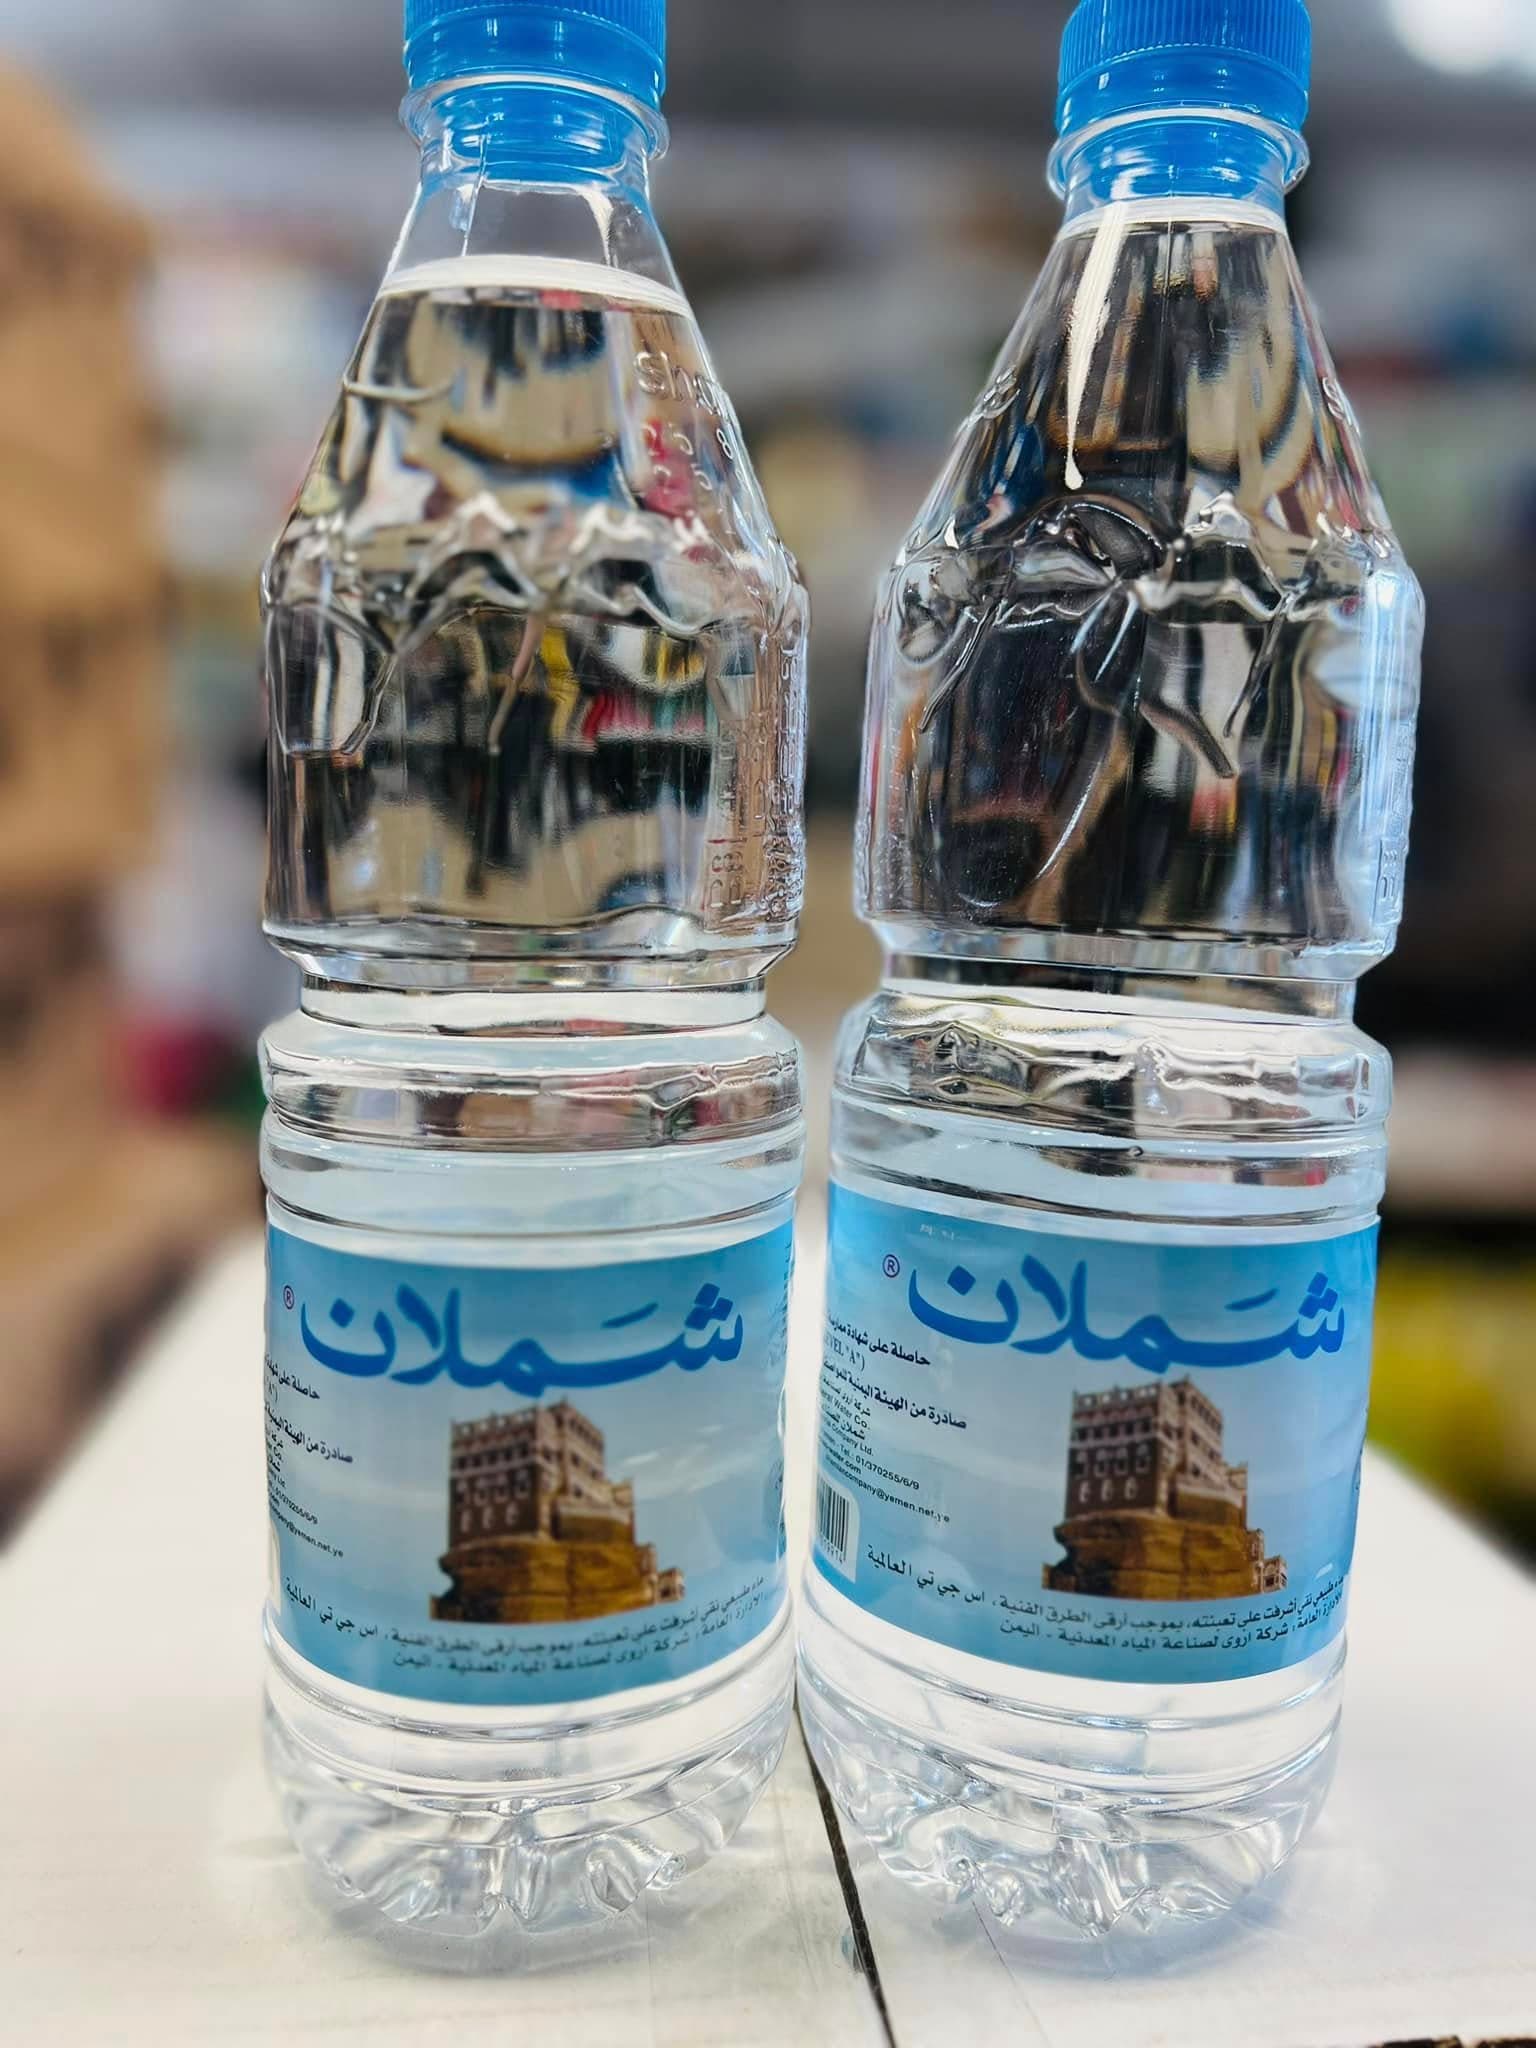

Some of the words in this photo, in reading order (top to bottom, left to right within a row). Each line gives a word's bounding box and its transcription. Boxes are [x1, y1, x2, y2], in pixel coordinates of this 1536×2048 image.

[891, 1342, 931, 1366] حاصلة
[910, 1402, 927, 1418] من
[929, 1406, 967, 1429] صادرة
[1256, 1622, 1289, 1641] شركة
